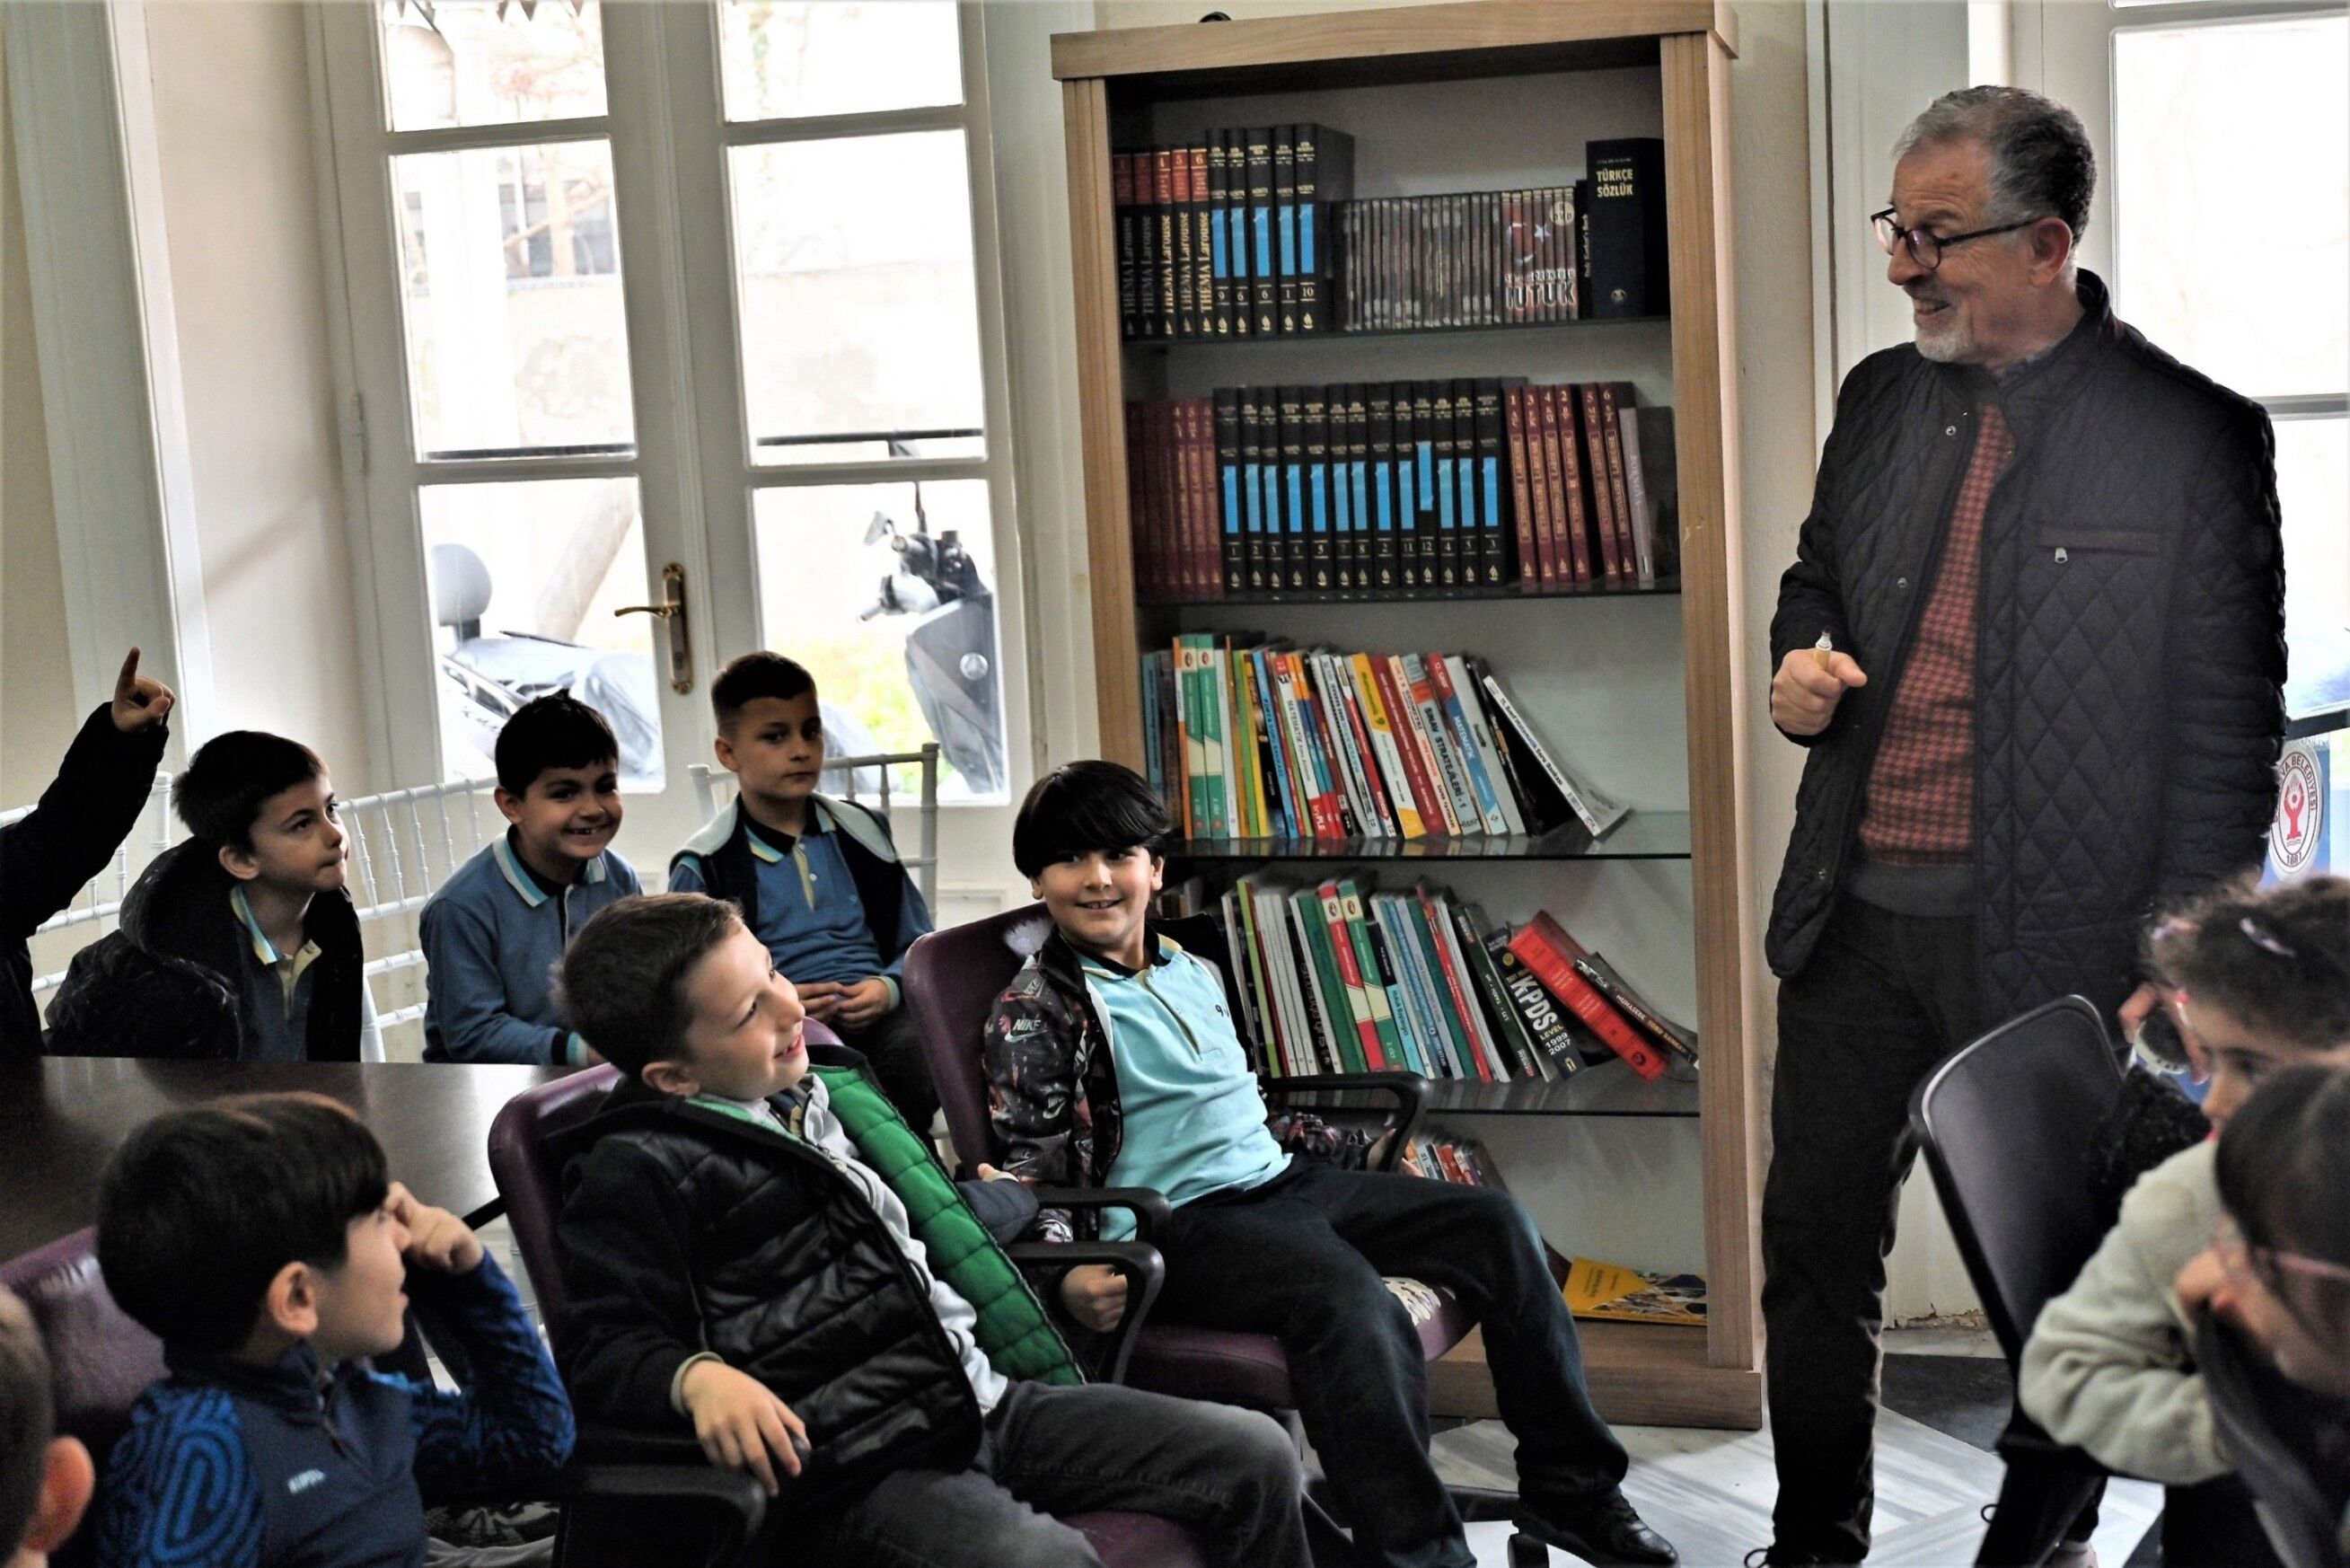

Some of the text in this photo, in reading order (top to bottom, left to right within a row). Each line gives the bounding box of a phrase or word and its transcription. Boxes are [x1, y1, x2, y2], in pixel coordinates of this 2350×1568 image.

[1195, 154, 1203, 165] 6
[1596, 168, 1633, 182] TÜRKÇE
[1597, 182, 1633, 198] SÖZLÜK
[1198, 211, 1210, 261] Larousse
[1261, 289, 1268, 299] 6
[1302, 286, 1314, 297] 10
[1510, 394, 1517, 406] 1
[1527, 394, 1534, 405] 3
[1560, 390, 1568, 401] 2
[1603, 389, 1611, 400] 6
[1252, 545, 1259, 555] 2
[1317, 544, 1324, 554] 5
[1359, 544, 1365, 554] 8
[1404, 542, 1413, 552] 11
[1421, 541, 1433, 551] 12
[1444, 542, 1451, 551] 4
[1433, 662, 1448, 691] 12. SINIF
[1376, 717, 1386, 726] 9
[1267, 724, 1277, 744] SORU
[1452, 714, 1475, 760] MATEMATİK
[1499, 697, 1564, 786] 11. Sınıf Matematik Soru Bankası
[1423, 706, 1439, 733] SINAV
[1434, 735, 1464, 797] STRATEJİLERİ
[2286, 852, 2302, 866] 1881
[1509, 973, 1559, 1033] KPDS
[1391, 990, 1409, 1036] Hukuk Başlangıcı
[1615, 992, 1646, 1021] MUHASEBE
[1646, 1018, 1664, 1035] SORU
[1013, 1018, 1042, 1031] NIKE
[1538, 1022, 1564, 1041] LEVEL
[1544, 1030, 1568, 1049] 1999
[1547, 1037, 1572, 1056] 2007
